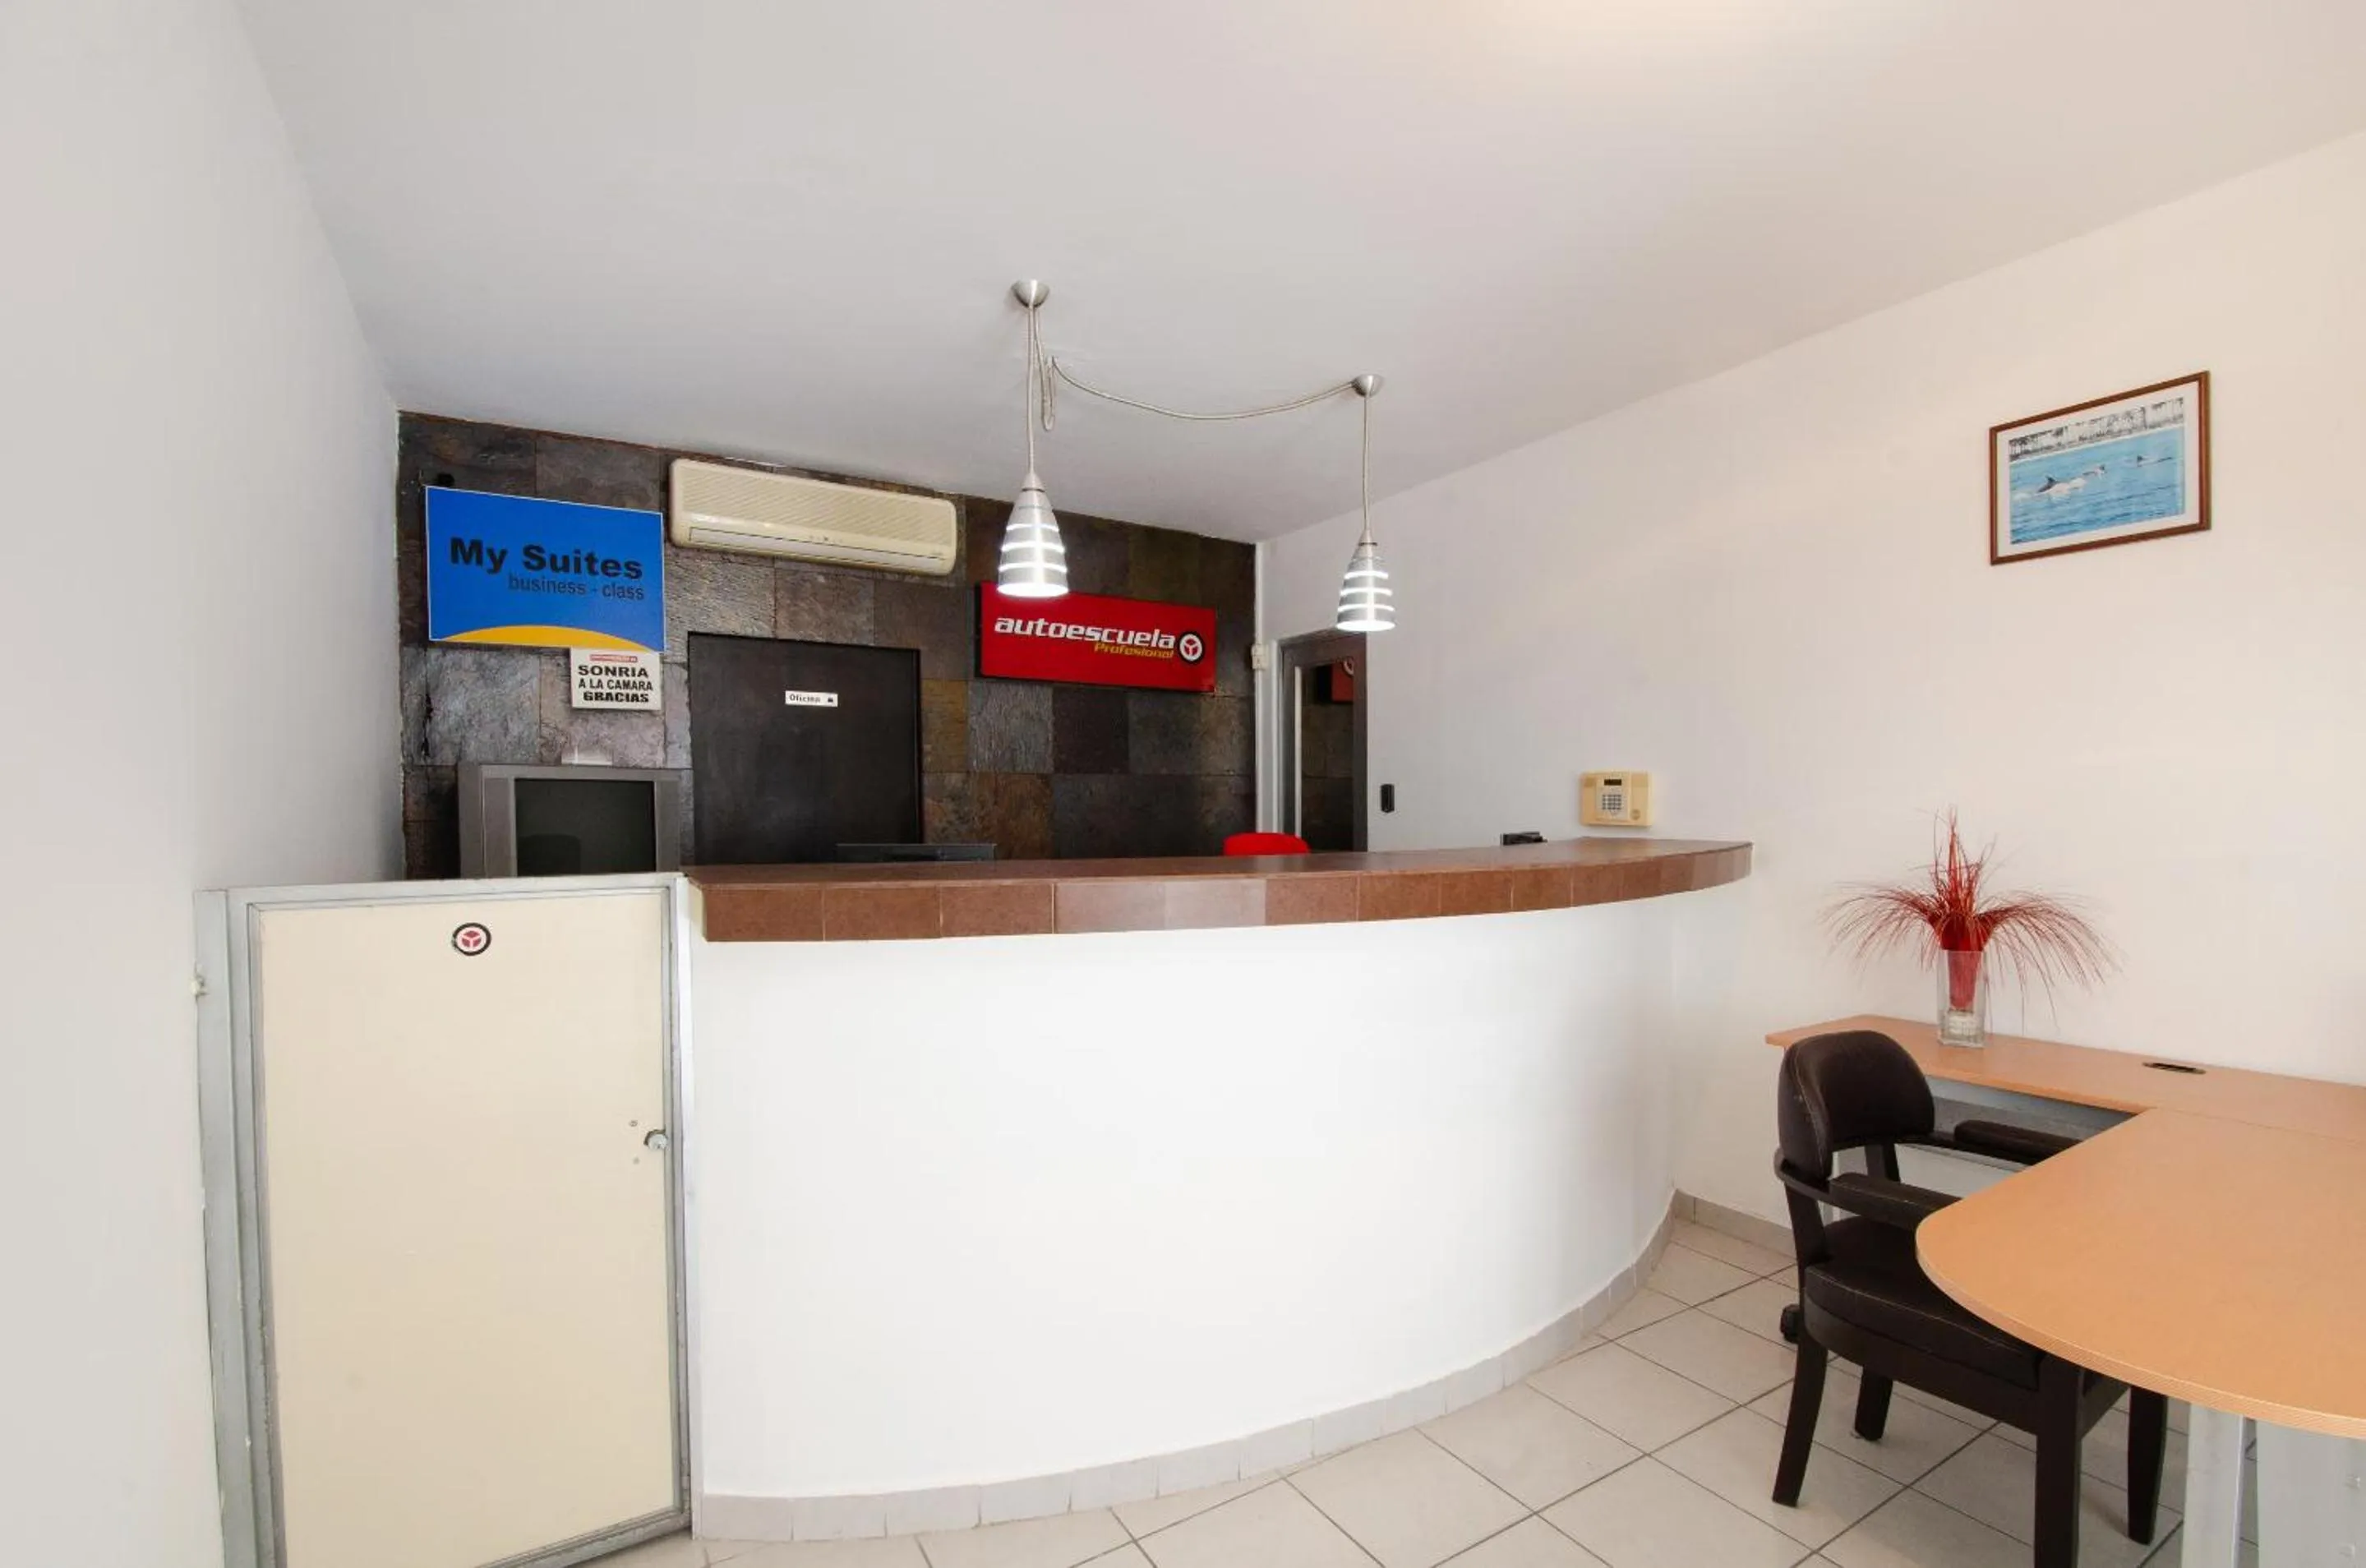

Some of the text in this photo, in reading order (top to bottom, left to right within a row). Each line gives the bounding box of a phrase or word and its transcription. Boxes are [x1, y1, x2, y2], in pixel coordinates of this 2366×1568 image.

[450, 537, 643, 579] My Suites
[508, 574, 586, 595] business
[602, 582, 645, 601] class
[994, 617, 1176, 649] autoescuela
[578, 665, 648, 678] SONRIA
[579, 678, 653, 690] A LA CAMARA
[583, 691, 649, 703] GRACIAS
